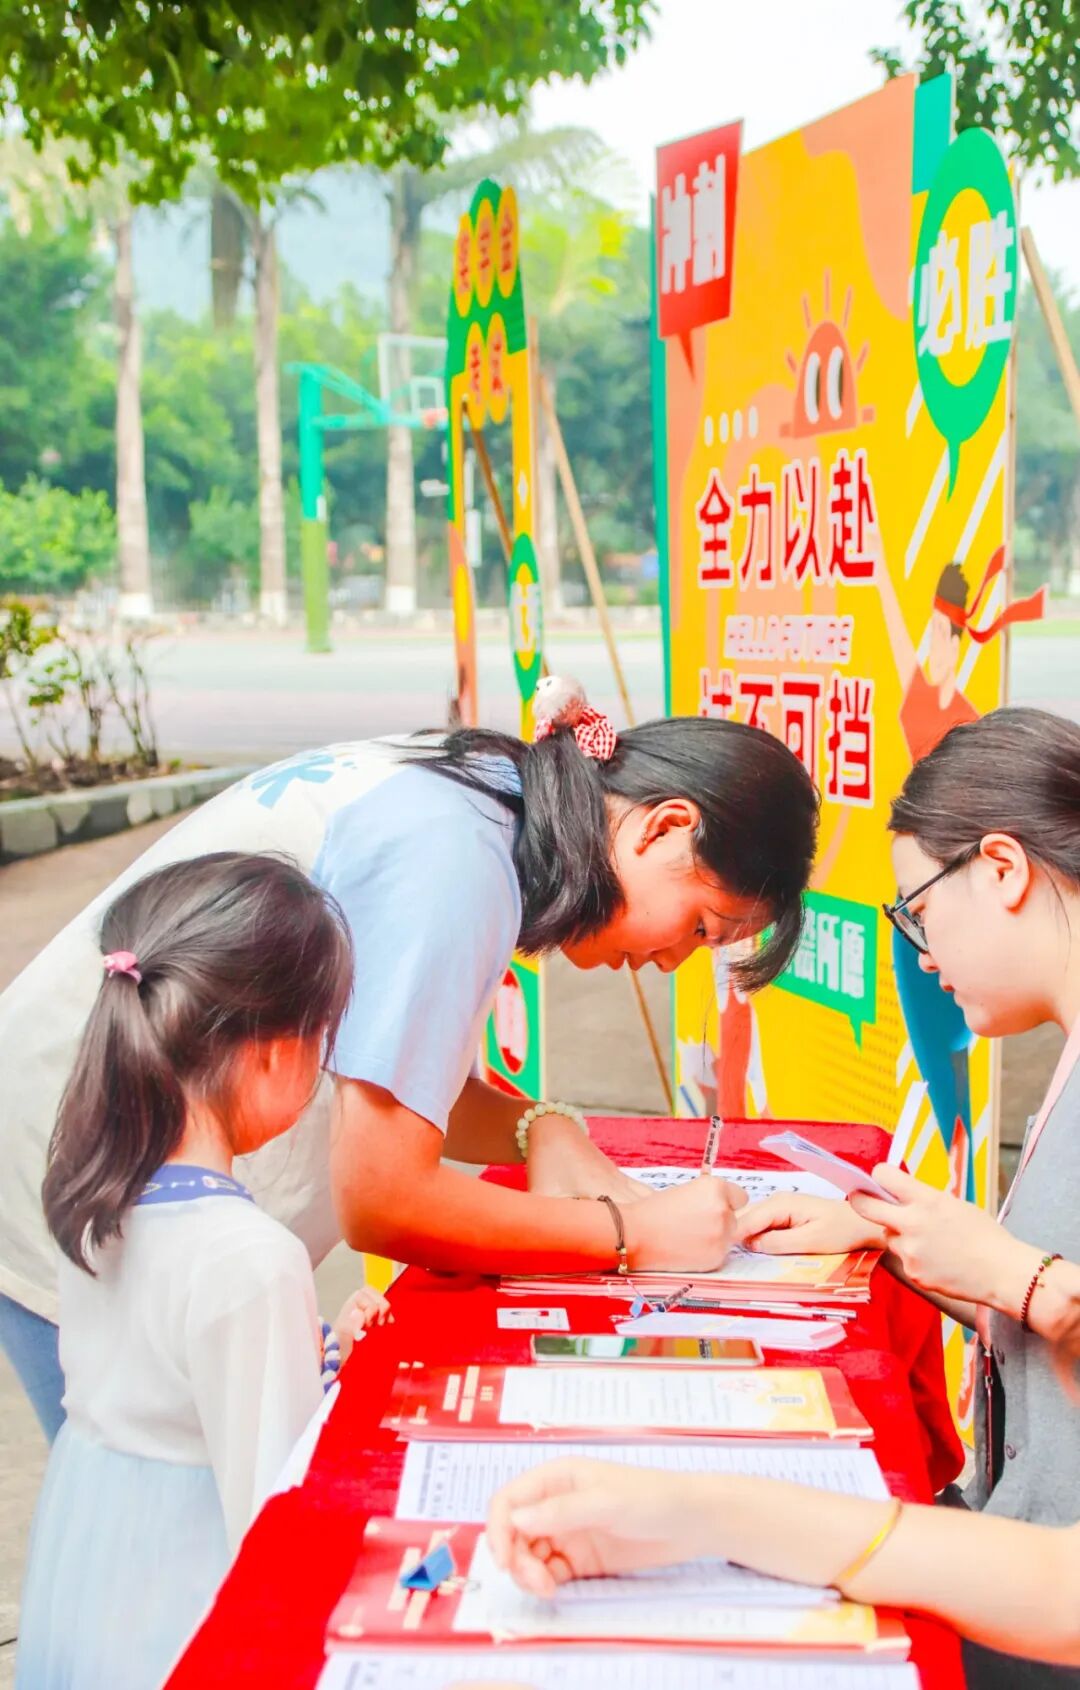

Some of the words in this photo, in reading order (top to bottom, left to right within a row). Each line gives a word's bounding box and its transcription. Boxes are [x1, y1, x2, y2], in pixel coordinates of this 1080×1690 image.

[917, 209, 1014, 357] 必胜
[697, 449, 876, 589] 全力以赴
